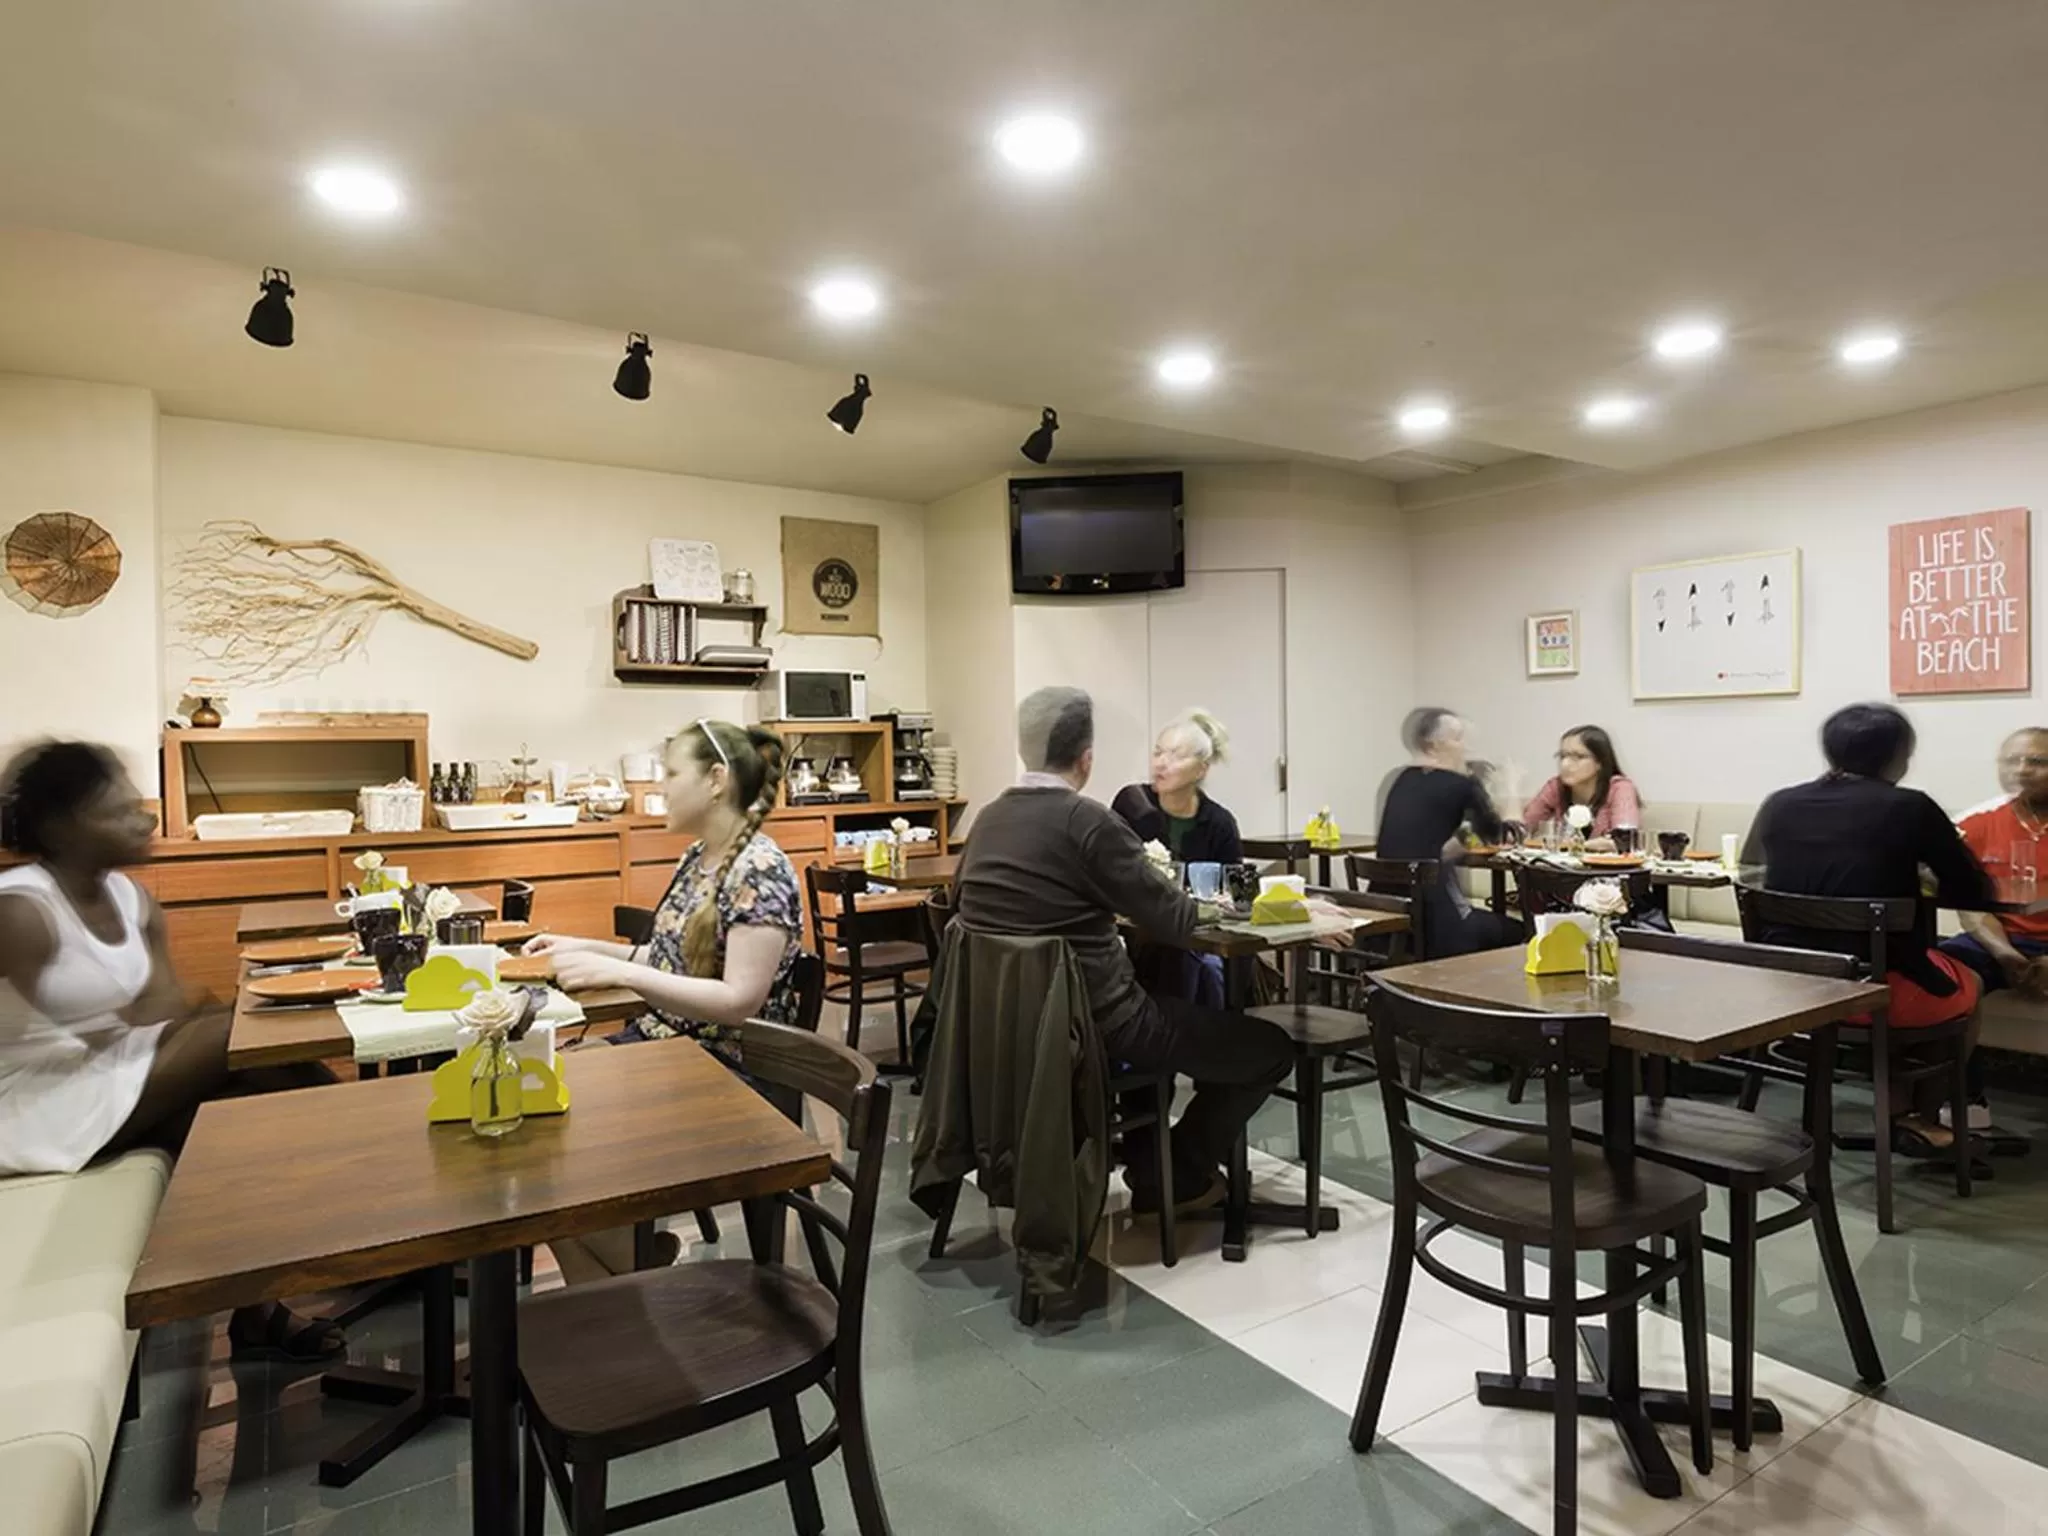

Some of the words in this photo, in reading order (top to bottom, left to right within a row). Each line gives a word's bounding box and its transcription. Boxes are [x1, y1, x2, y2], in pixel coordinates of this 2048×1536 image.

[1918, 529, 1966, 568] LIFE
[1975, 526, 1996, 562] IS
[1908, 561, 2007, 604] BETTER
[1900, 604, 1932, 641] AT
[1967, 598, 2019, 635] THE
[1917, 636, 2000, 676] BEACH
